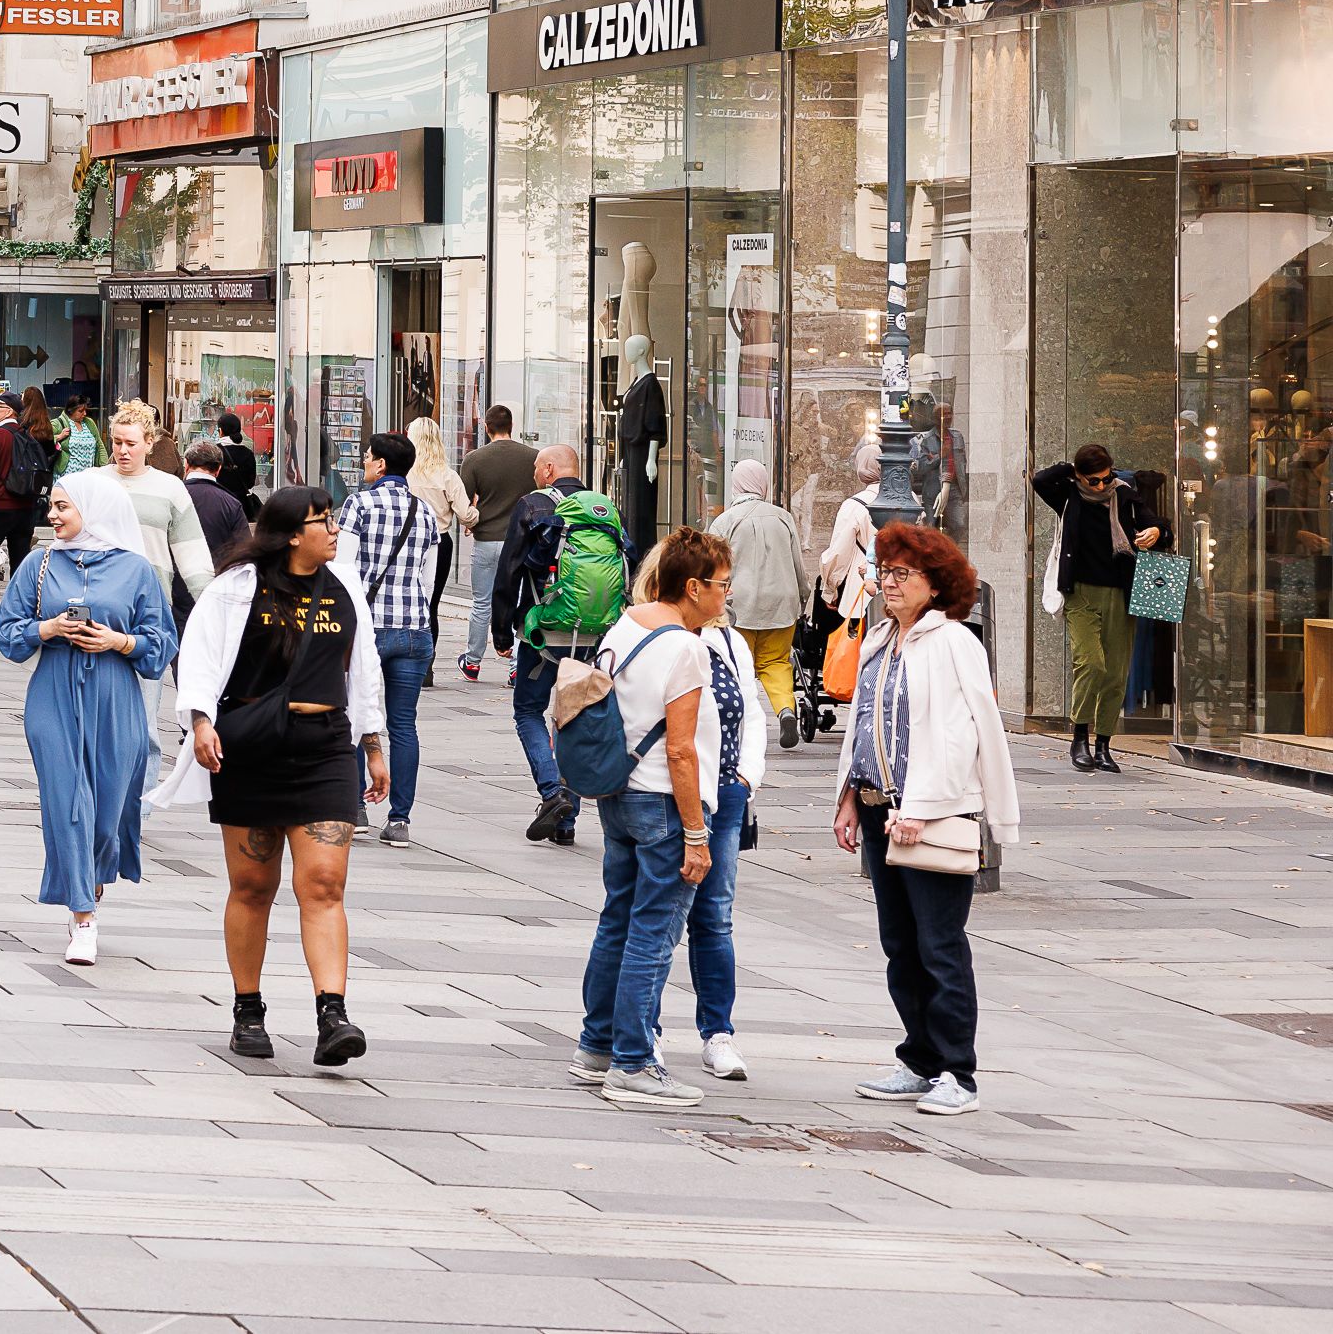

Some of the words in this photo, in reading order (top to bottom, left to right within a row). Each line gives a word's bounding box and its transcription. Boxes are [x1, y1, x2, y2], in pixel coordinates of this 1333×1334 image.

[7, 8, 120, 28] FESSLER
[332, 157, 377, 193] LLOYD
[343, 197, 365, 211] GERMANY
[732, 238, 768, 252] CALZEDONIA
[171, 284, 182, 298] UND
[183, 284, 213, 298] GESCHENKE
